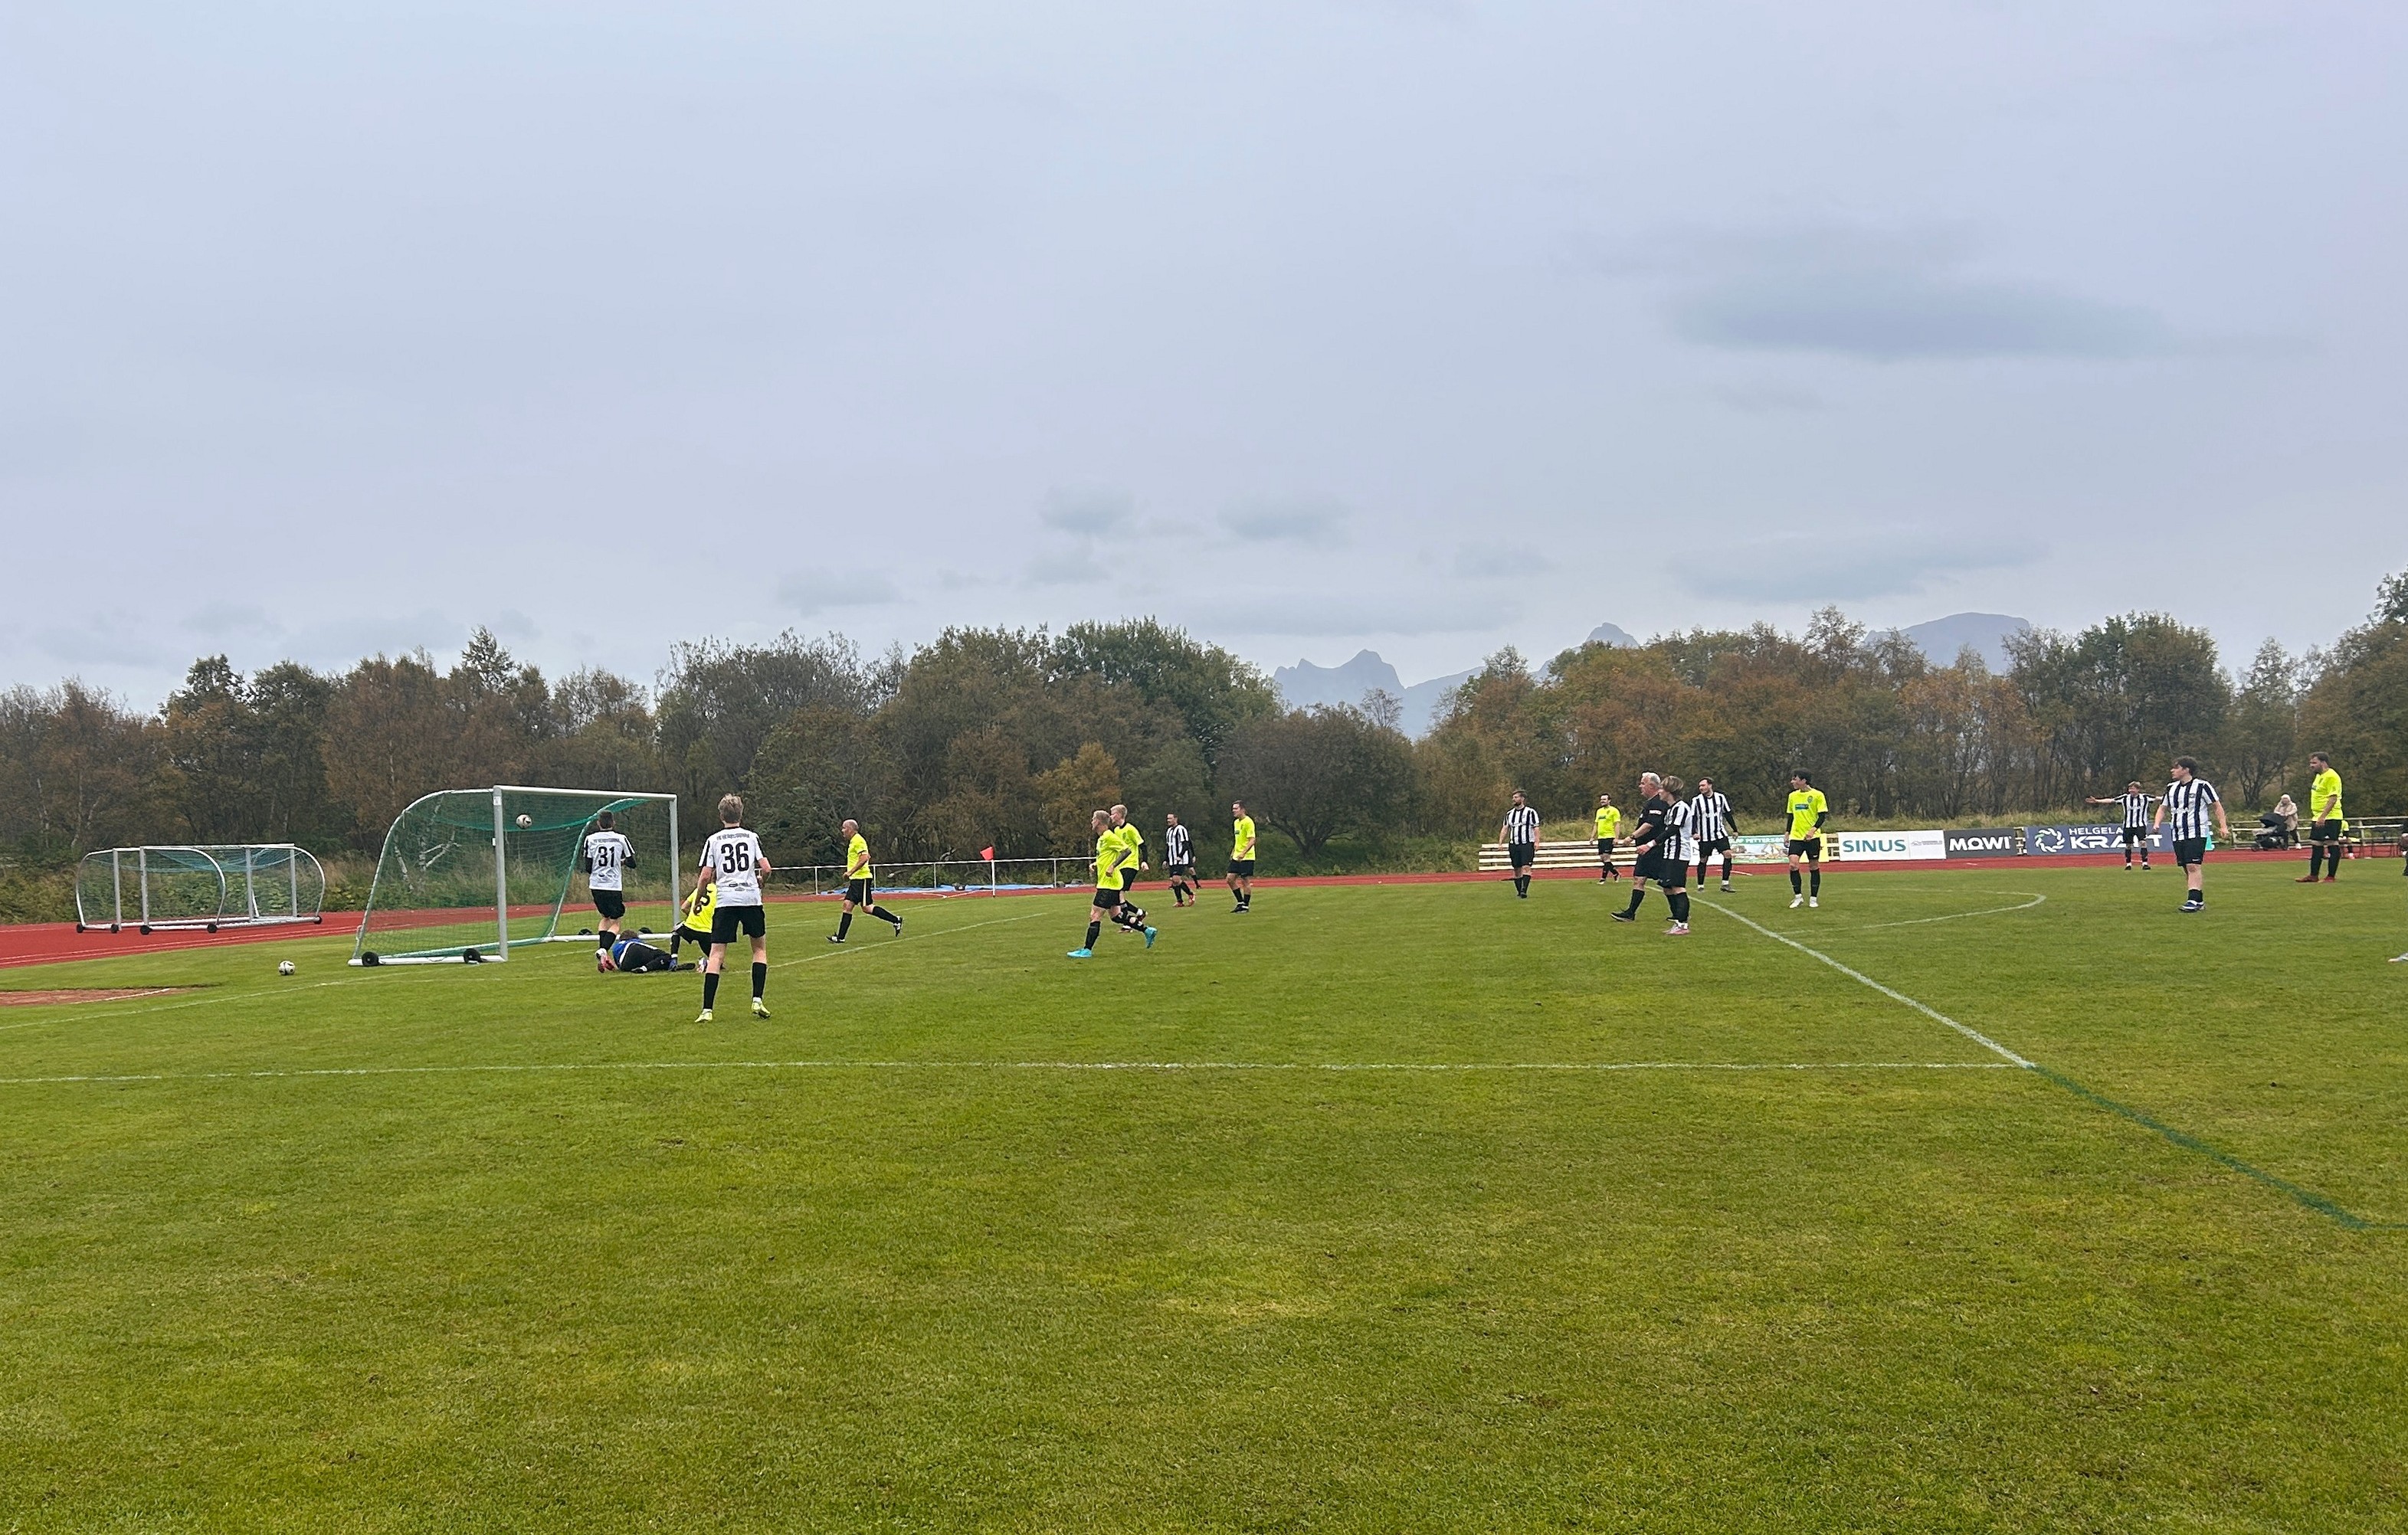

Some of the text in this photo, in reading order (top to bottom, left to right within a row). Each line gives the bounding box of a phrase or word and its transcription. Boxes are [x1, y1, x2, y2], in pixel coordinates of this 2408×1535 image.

[1842, 839, 1907, 853] SINUS
[1949, 836, 2011, 852] MOWI
[598, 846, 614, 867] 31
[721, 842, 750, 873] 36
